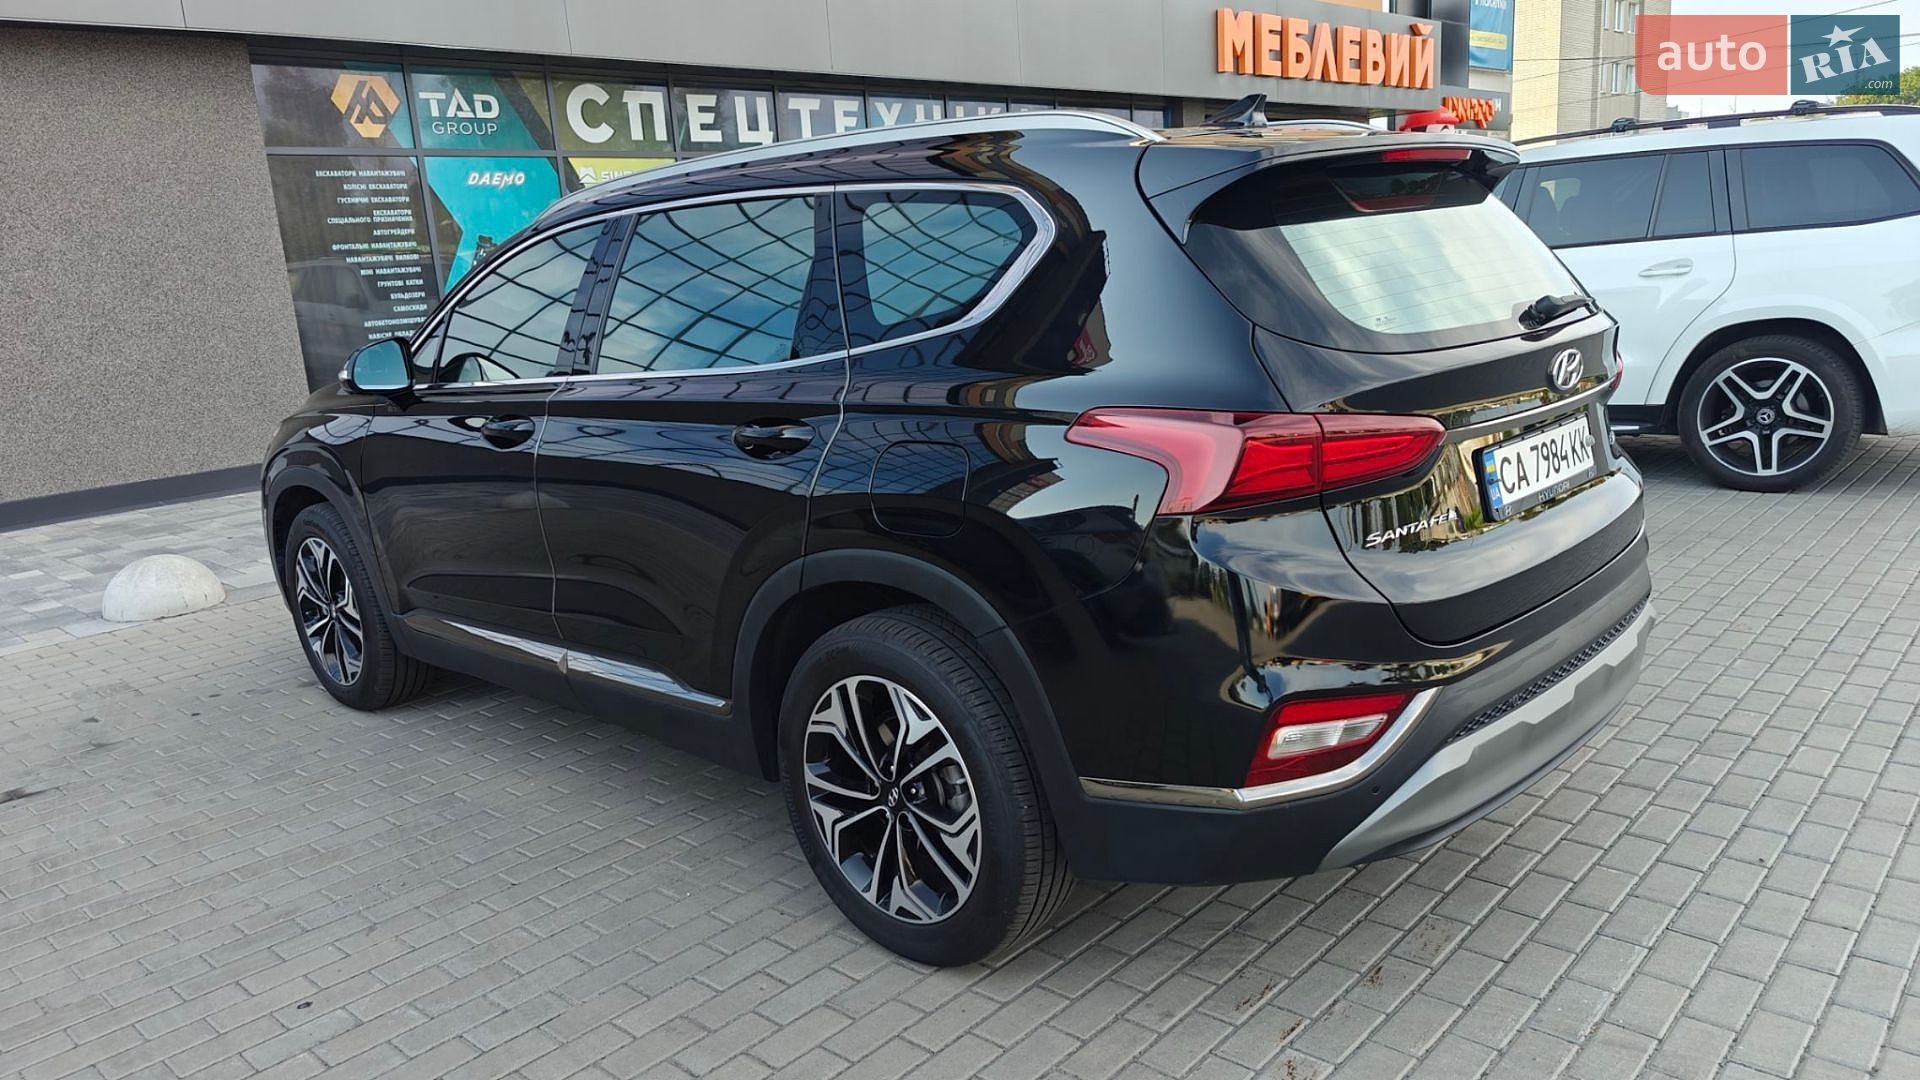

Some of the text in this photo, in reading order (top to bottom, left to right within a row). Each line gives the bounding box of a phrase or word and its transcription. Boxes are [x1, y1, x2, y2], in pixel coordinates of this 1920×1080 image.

[1217, 8, 1435, 89] МЕБЛЕВИЙ
[418, 88, 500, 119] TAD
[566, 83, 1032, 147] СПЕЦТЕХ
[432, 121, 497, 135] GROUP
[467, 171, 525, 189] DAEMO
[1499, 451, 1530, 495] CA
[1530, 434, 1570, 483] 7984
